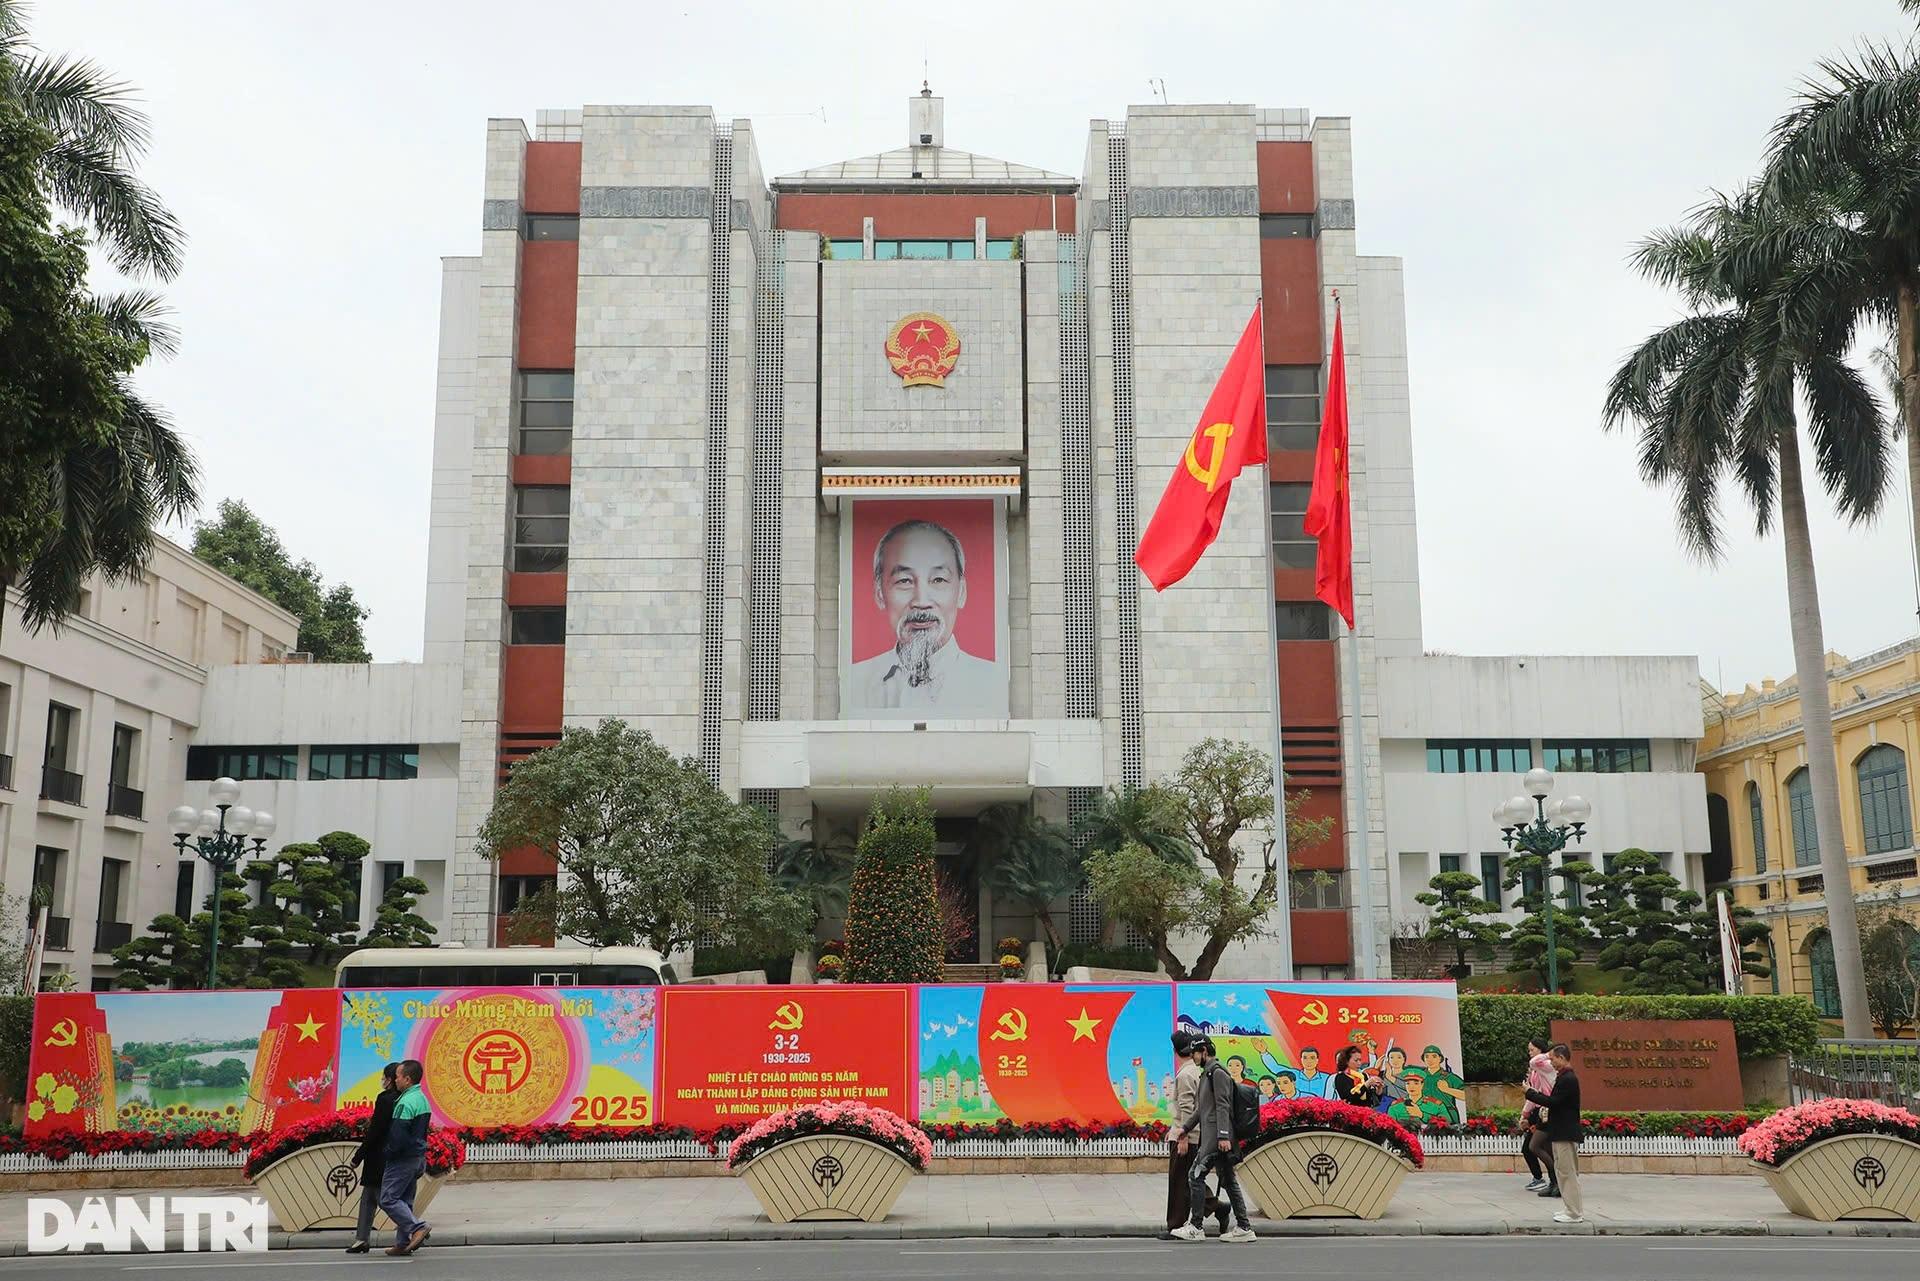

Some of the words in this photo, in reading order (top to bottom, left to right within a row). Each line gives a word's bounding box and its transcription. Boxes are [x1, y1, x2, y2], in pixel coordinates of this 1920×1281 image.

[402, 1000, 450, 1018] Chúc
[456, 999, 507, 1021] Mừng
[512, 999, 555, 1017] Năm
[560, 999, 593, 1017] Mới
[1338, 1007, 1369, 1023] 3-2
[775, 1034, 799, 1050] 3-2
[763, 1053, 811, 1063] 1930-2025
[998, 1055, 1027, 1069] 3-2
[708, 1072, 736, 1084] NHIỆT
[739, 1071, 758, 1084] LIỆT
[761, 1071, 786, 1082] CHÀO
[789, 1071, 818, 1082] MỪNG
[821, 1072, 833, 1082] 95
[836, 1071, 858, 1081] NĂM
[678, 1087, 703, 1098] NGÀY
[706, 1087, 738, 1098] THÀNH
[741, 1087, 758, 1100] LẬP
[761, 1086, 788, 1098] ĐẢNG
[791, 1086, 817, 1100] CỘNG
[820, 1085, 840, 1097] SẢN
[843, 1086, 863, 1099] VIỆT
[866, 1087, 888, 1096] NAM
[571, 1096, 647, 1120] 2025
[715, 1103, 728, 1114] VÀ
[731, 1102, 760, 1114] MỪNG
